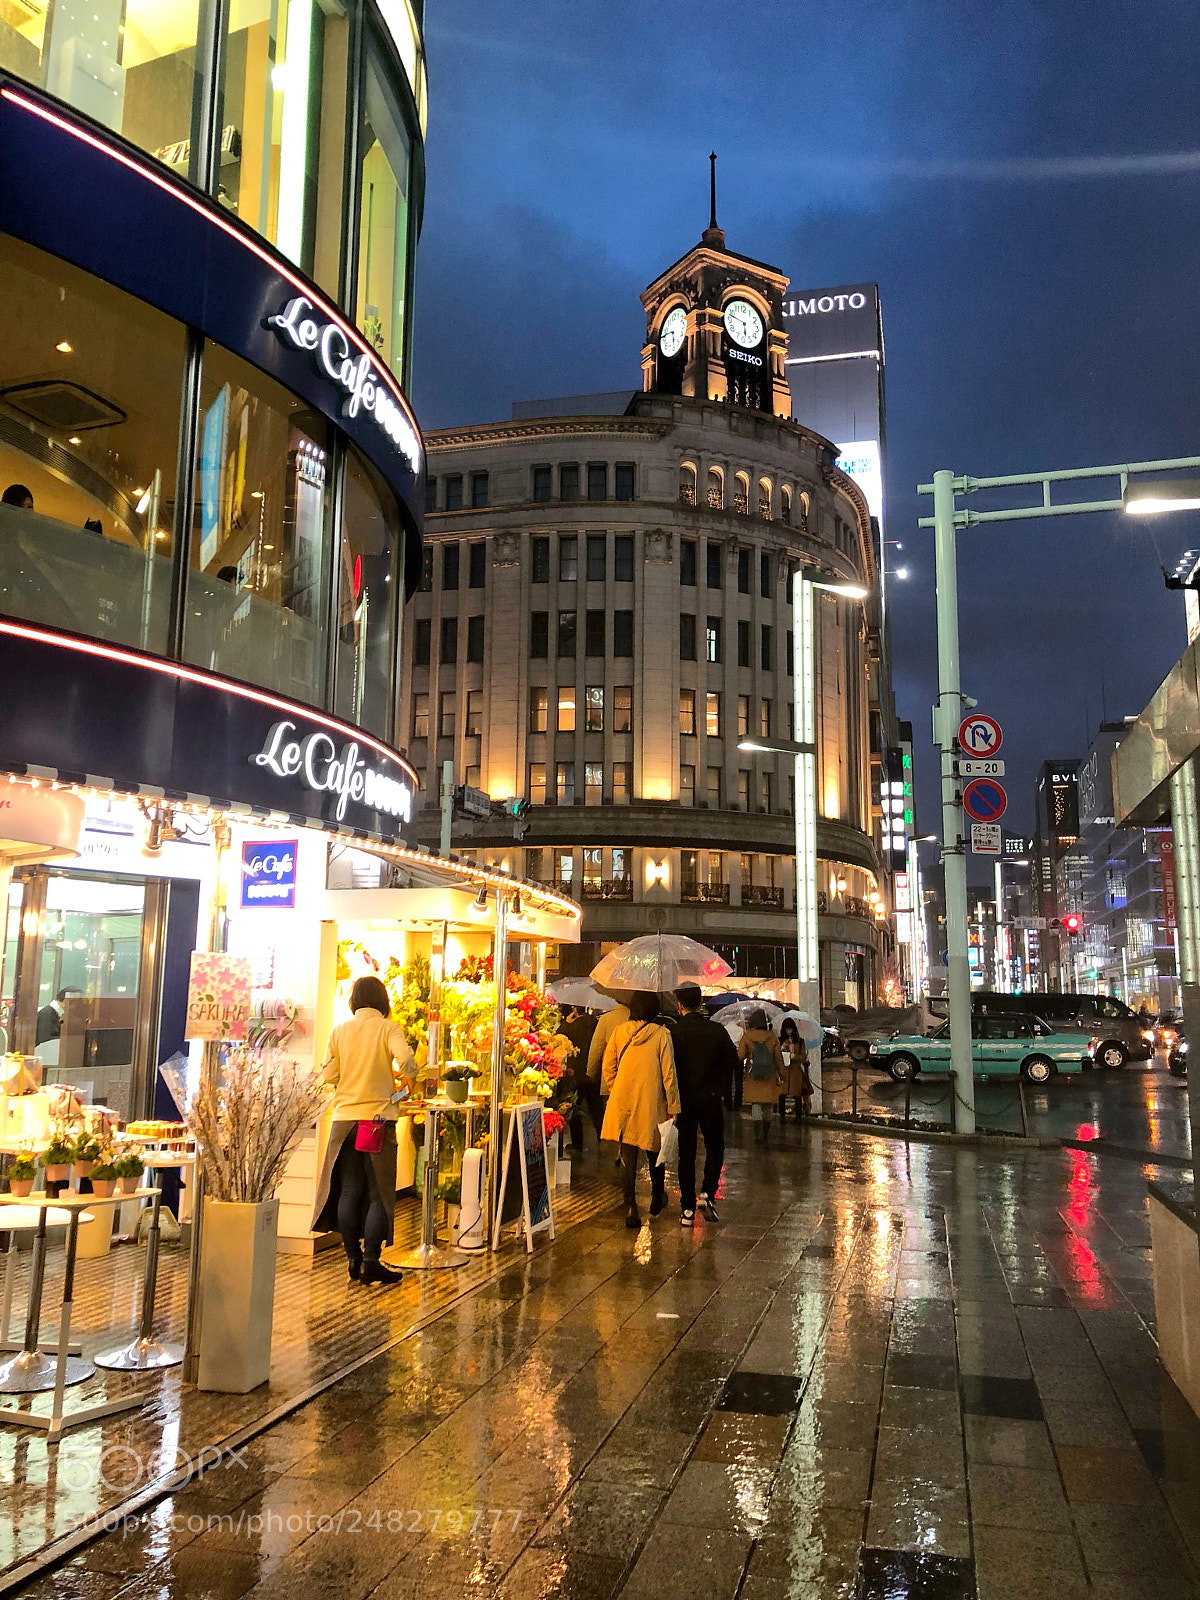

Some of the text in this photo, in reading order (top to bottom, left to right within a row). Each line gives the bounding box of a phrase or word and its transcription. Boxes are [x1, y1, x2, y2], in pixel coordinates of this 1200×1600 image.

[275, 296, 377, 418] Le Café
[729, 349, 762, 366] SEIKO
[255, 721, 302, 777] Le
[305, 733, 365, 821] Café
[189, 1003, 246, 1021] SAKURA
